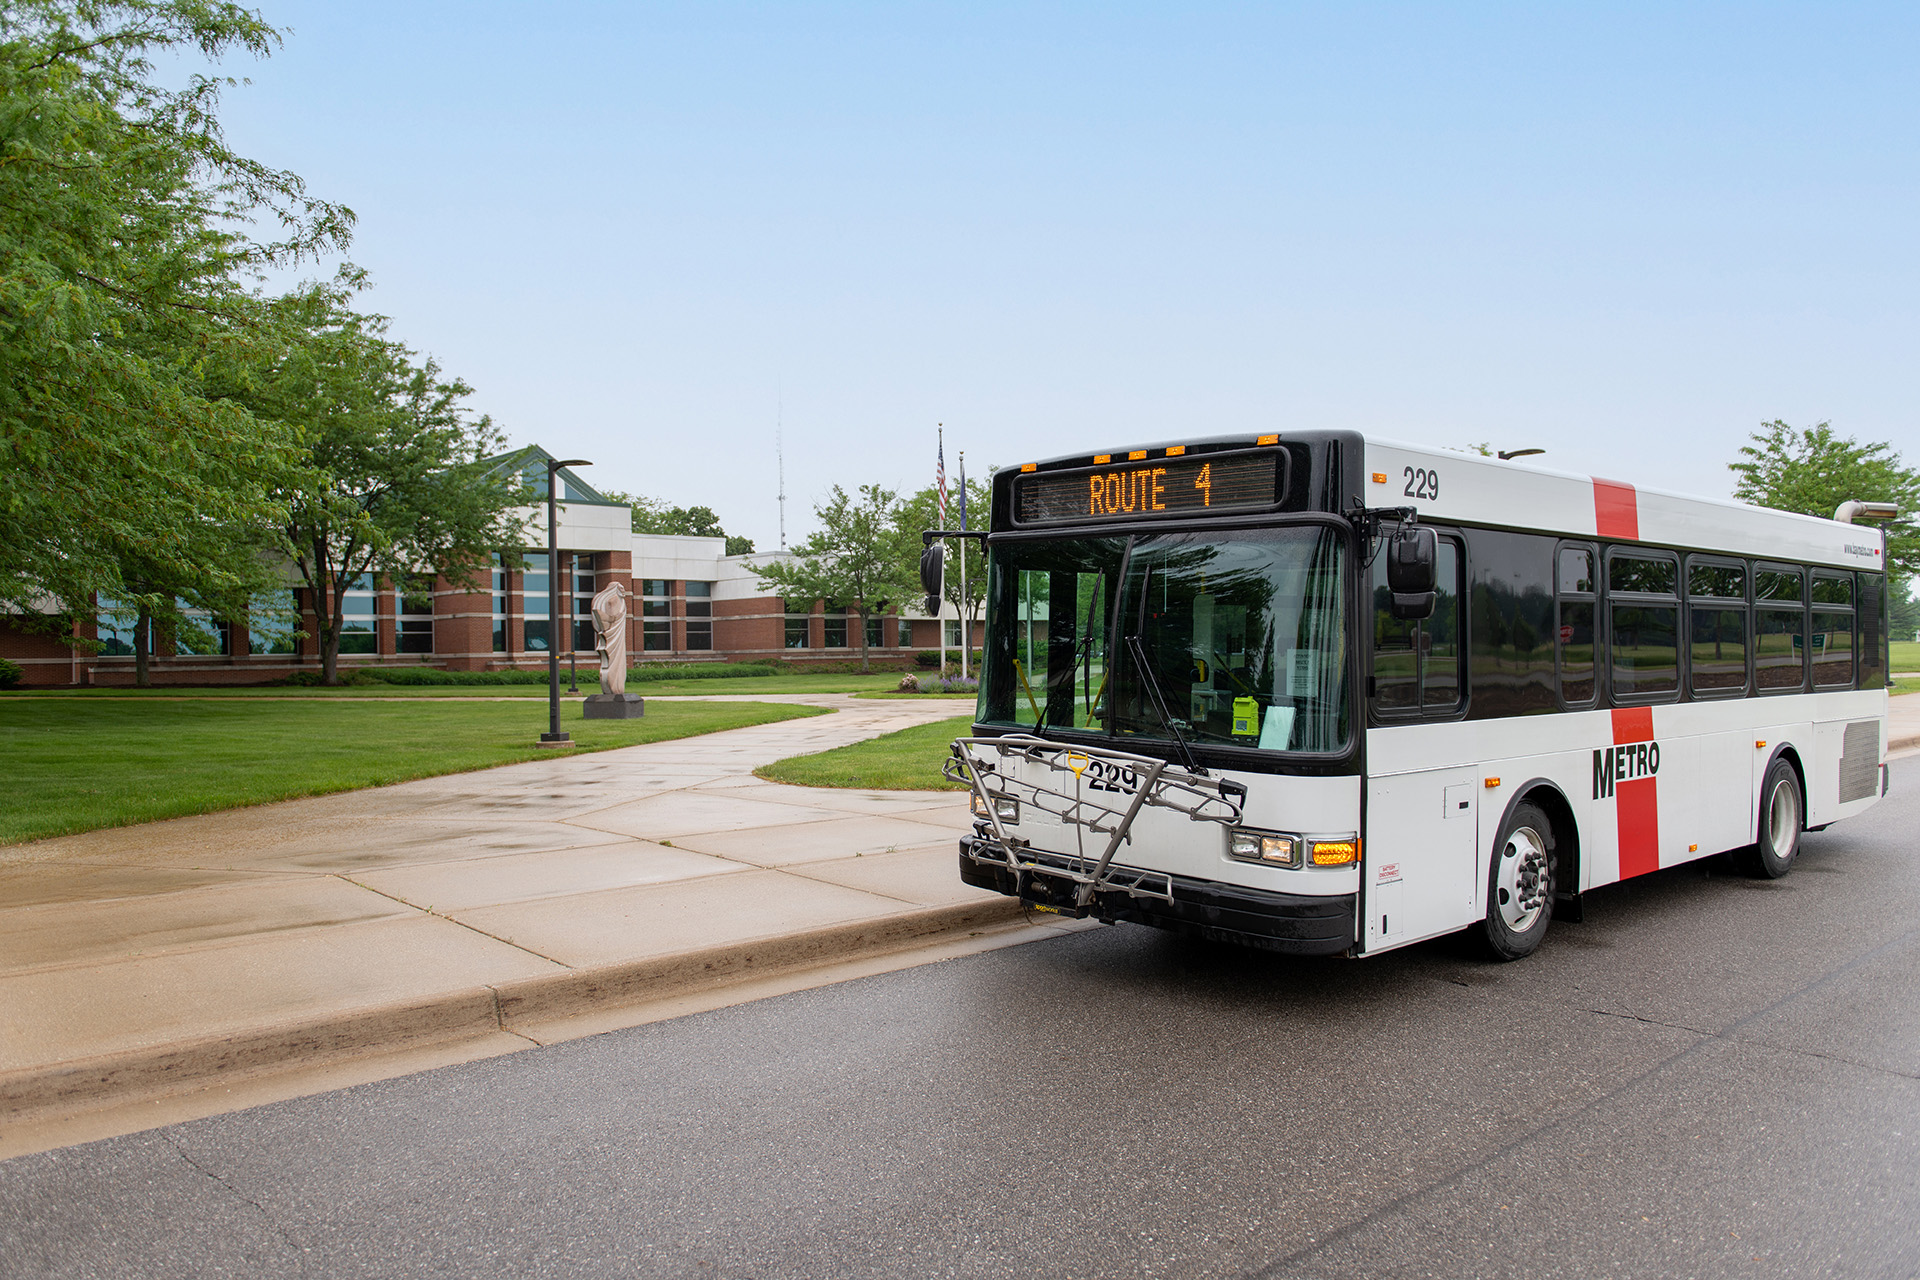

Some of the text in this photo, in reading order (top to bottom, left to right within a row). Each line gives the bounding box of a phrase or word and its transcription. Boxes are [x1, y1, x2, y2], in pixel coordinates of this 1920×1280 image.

[1090, 463, 1211, 515] ROUTE 4
[1404, 466, 1439, 501] 229
[1089, 761, 1138, 795] 229
[1592, 742, 1660, 800] METRO
